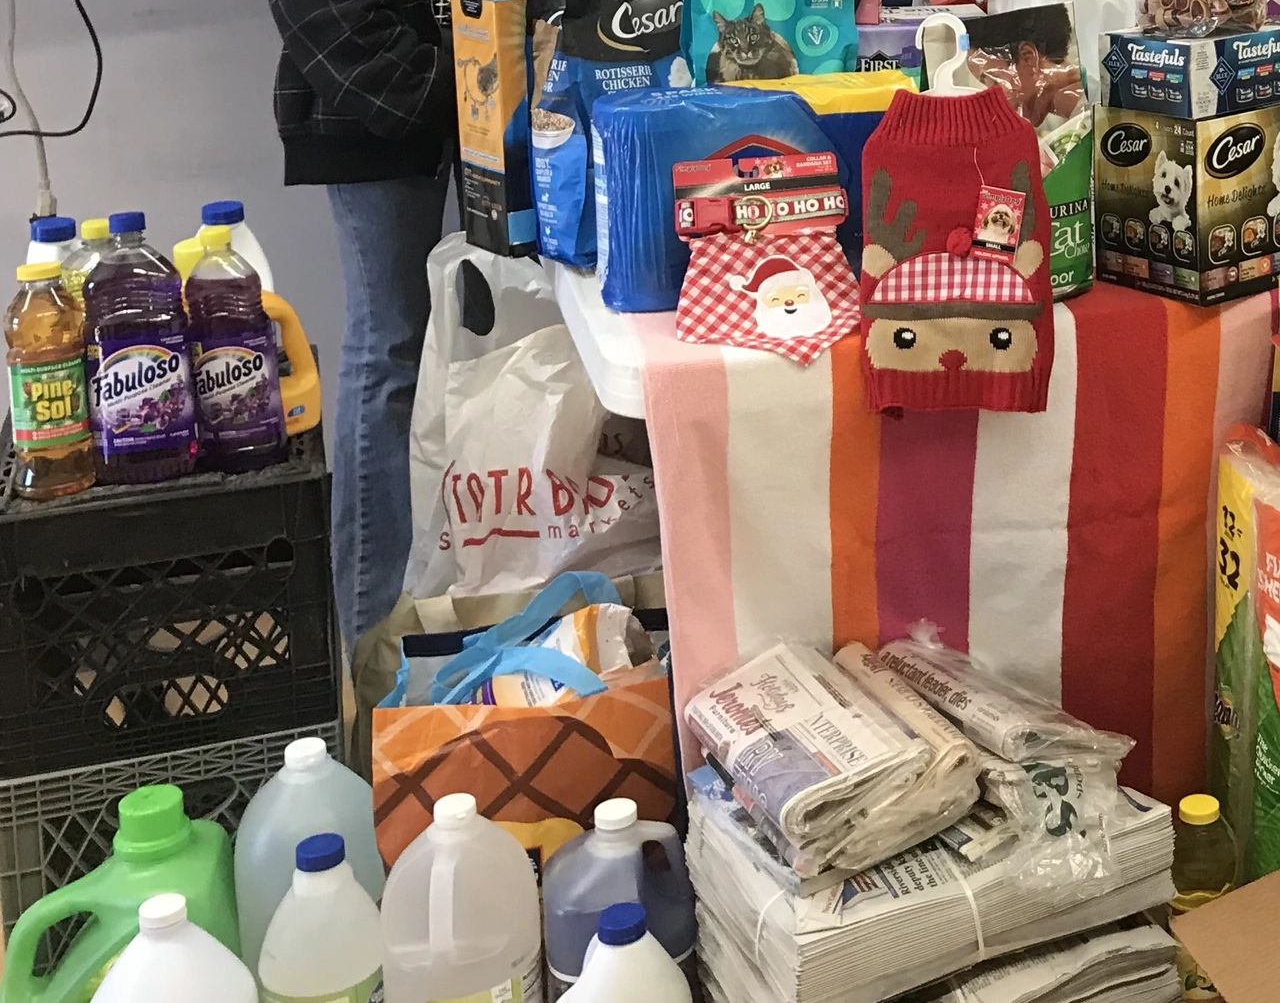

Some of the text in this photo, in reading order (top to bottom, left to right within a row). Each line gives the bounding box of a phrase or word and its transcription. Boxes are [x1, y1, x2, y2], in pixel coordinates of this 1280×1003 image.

[611, 1, 684, 38] Cesar
[861, 58, 899, 72] FIRST
[1128, 43, 1185, 68] Tastefuls
[602, 76, 651, 91] CHICKEN
[1173, 124, 1182, 135] 24
[1107, 129, 1148, 156] Cesar
[1211, 134, 1260, 169] Cesar
[743, 182, 771, 191] LARGE
[1207, 183, 1266, 208] Home Delights
[736, 204, 760, 219] HO
[793, 197, 820, 215] HO
[985, 242, 1001, 250] SMALL
[31, 379, 73, 401] Pine
[91, 353, 180, 407] Fabuloso
[36, 396, 72, 422] Sol
[880, 651, 891, 662] a
[885, 655, 928, 687] reluctant
[921, 671, 954, 703] leader,
[948, 689, 972, 711] dies
[709, 704, 737, 734] Furniture
